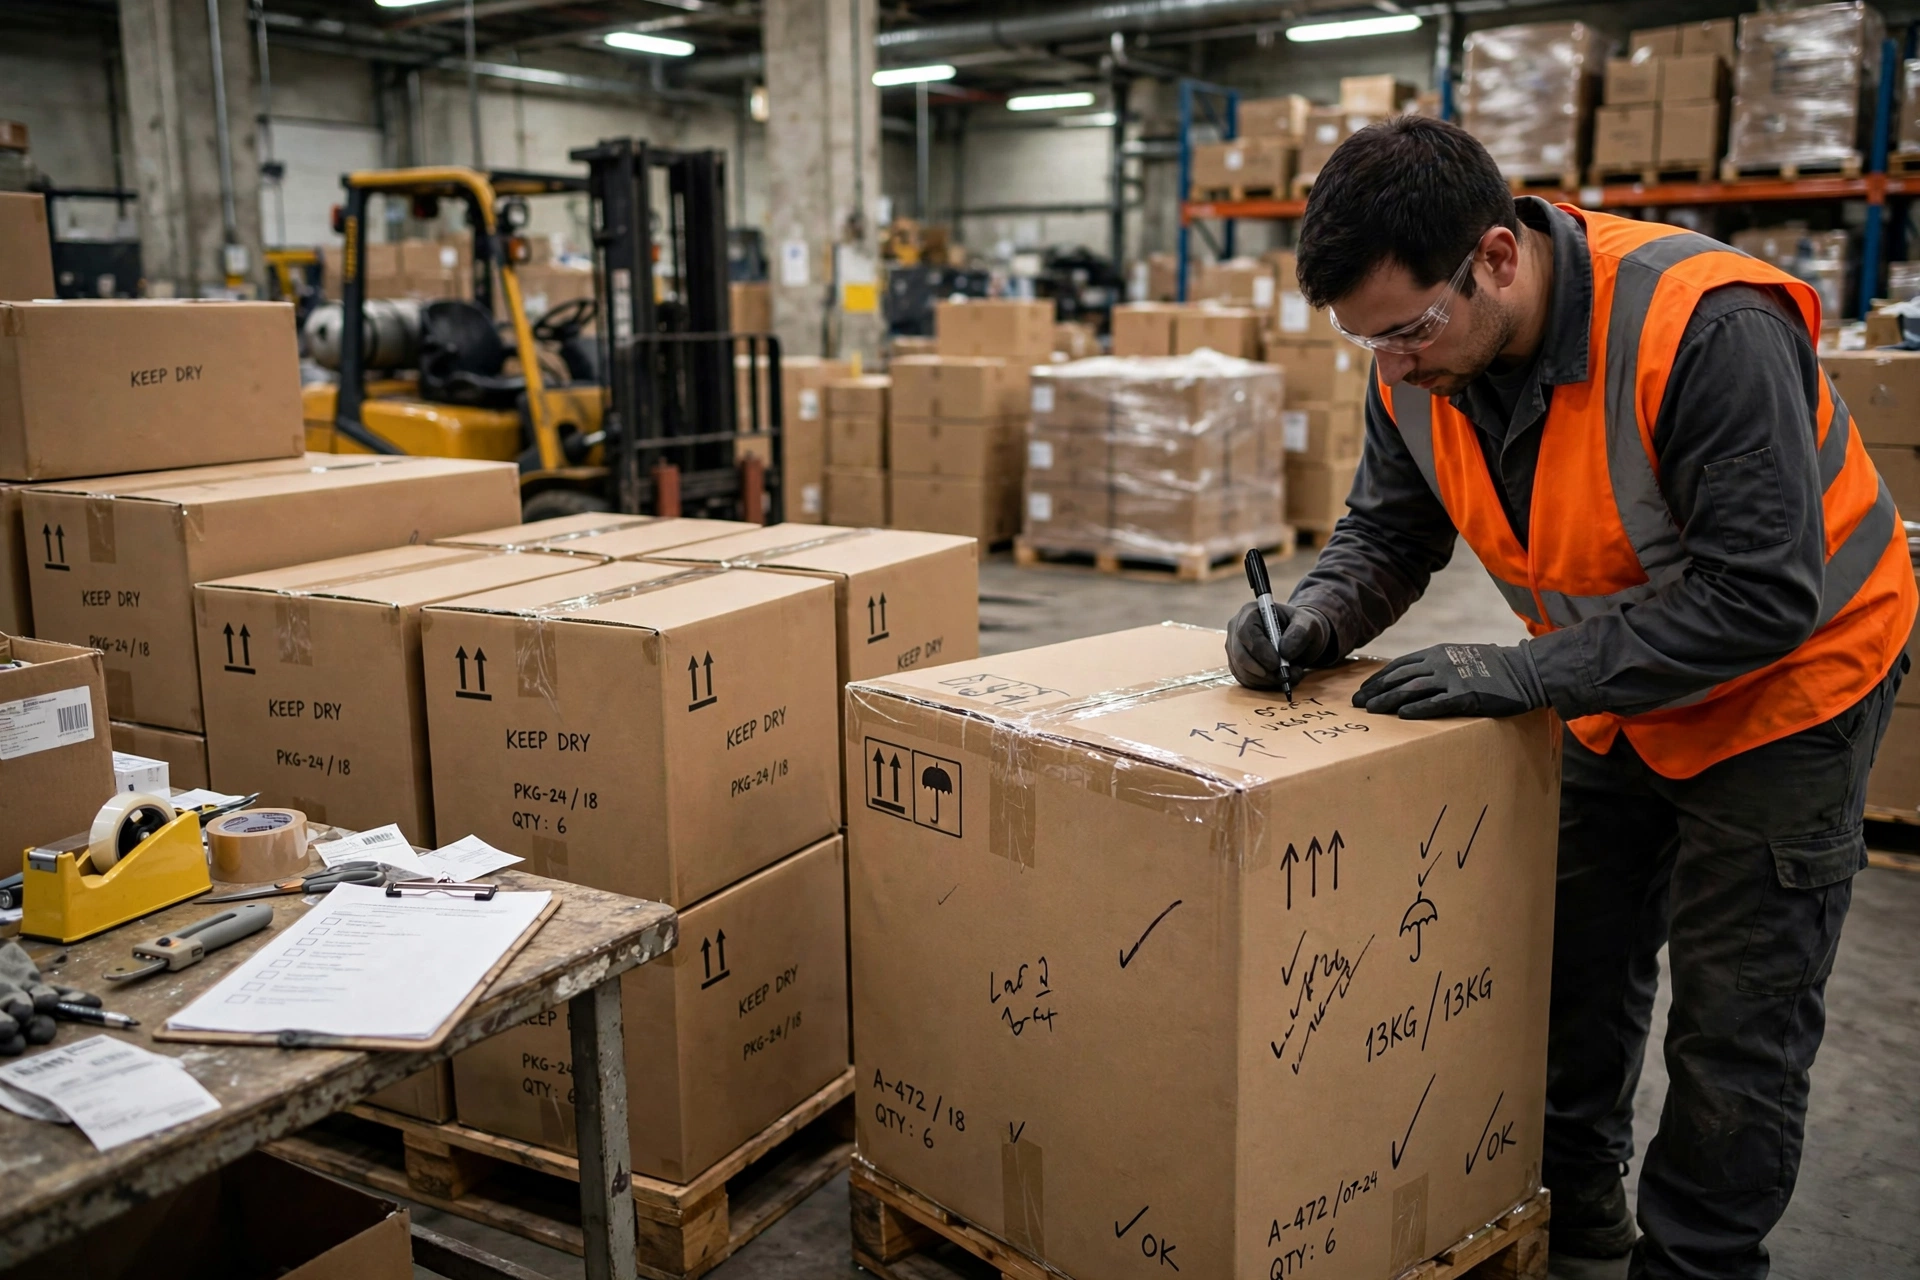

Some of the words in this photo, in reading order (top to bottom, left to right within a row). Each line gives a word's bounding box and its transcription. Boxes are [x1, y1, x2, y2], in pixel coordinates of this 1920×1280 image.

[130, 367, 168, 388] KEEP
[175, 364, 203, 383] DRY
[81, 589, 112, 608] KEEP
[117, 590, 141, 608] DRY
[897, 645, 922, 671] KEEP
[925, 635, 944, 659] DRY
[268, 698, 305, 719] KEEP
[313, 701, 342, 722] DRY
[506, 728, 549, 750] KEEP
[557, 732, 592, 754] DRY
[726, 719, 759, 751] KEEP
[763, 705, 787, 734] DRY
[511, 810, 550, 832] QTY:
[556, 816, 568, 835] 6
[738, 983, 771, 1019] KEEP
[775, 963, 799, 994] DRY
[522, 1077, 559, 1099] QTY:
[874, 1103, 915, 1138] QTY:
[922, 1126, 935, 1150] 6
[1484, 1120, 1518, 1162] OK
[1141, 1233, 1181, 1272] OK
[1324, 1226, 1338, 1255] 6
